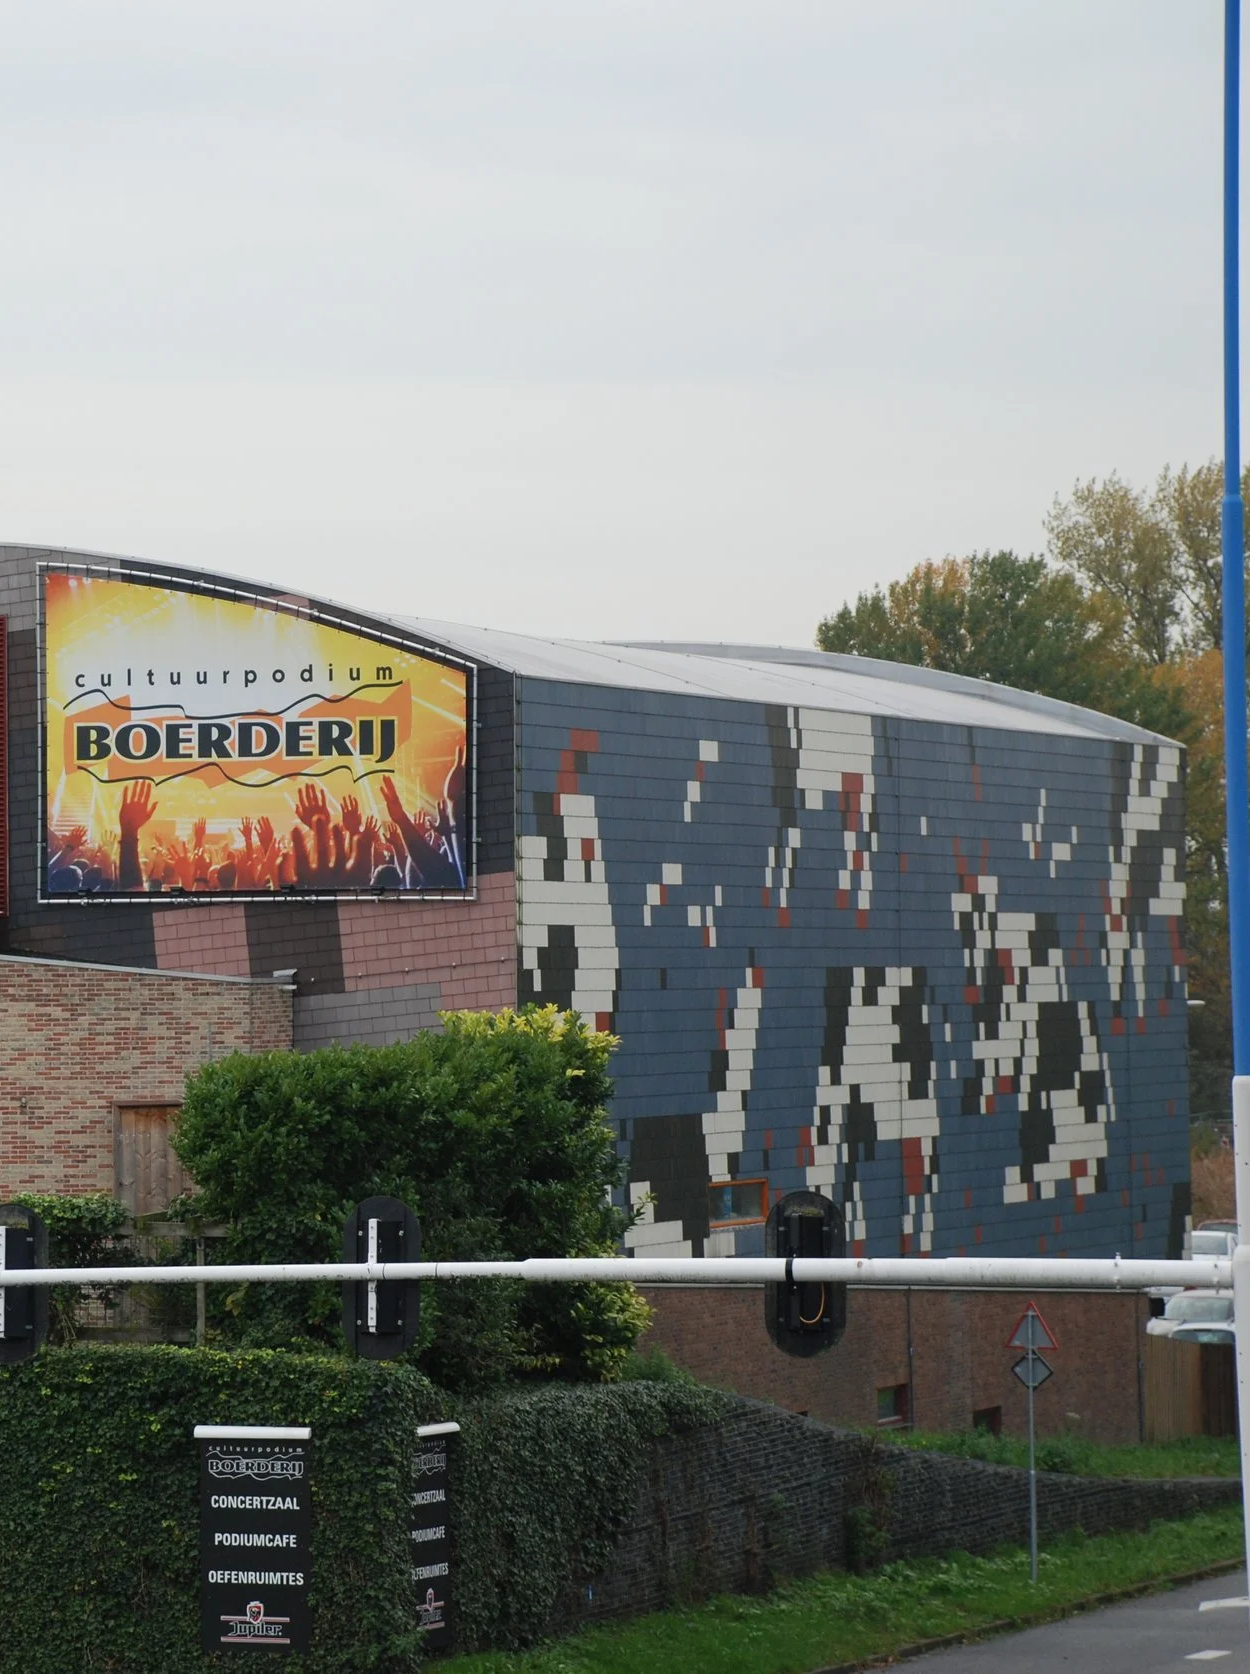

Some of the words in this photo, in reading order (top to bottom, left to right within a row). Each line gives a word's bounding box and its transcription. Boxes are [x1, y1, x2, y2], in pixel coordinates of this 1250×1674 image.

[75, 664, 393, 688] cultuurpodium
[76, 719, 395, 763] BOERDERIJ
[208, 1445, 303, 1453] cultuurpodium
[208, 1459, 304, 1476] BOERDERIJ
[211, 1495, 300, 1510] CONCERTZAAL
[214, 1533, 297, 1547] PODIUMCAFE
[208, 1570, 304, 1585] OEFENRUIMTES
